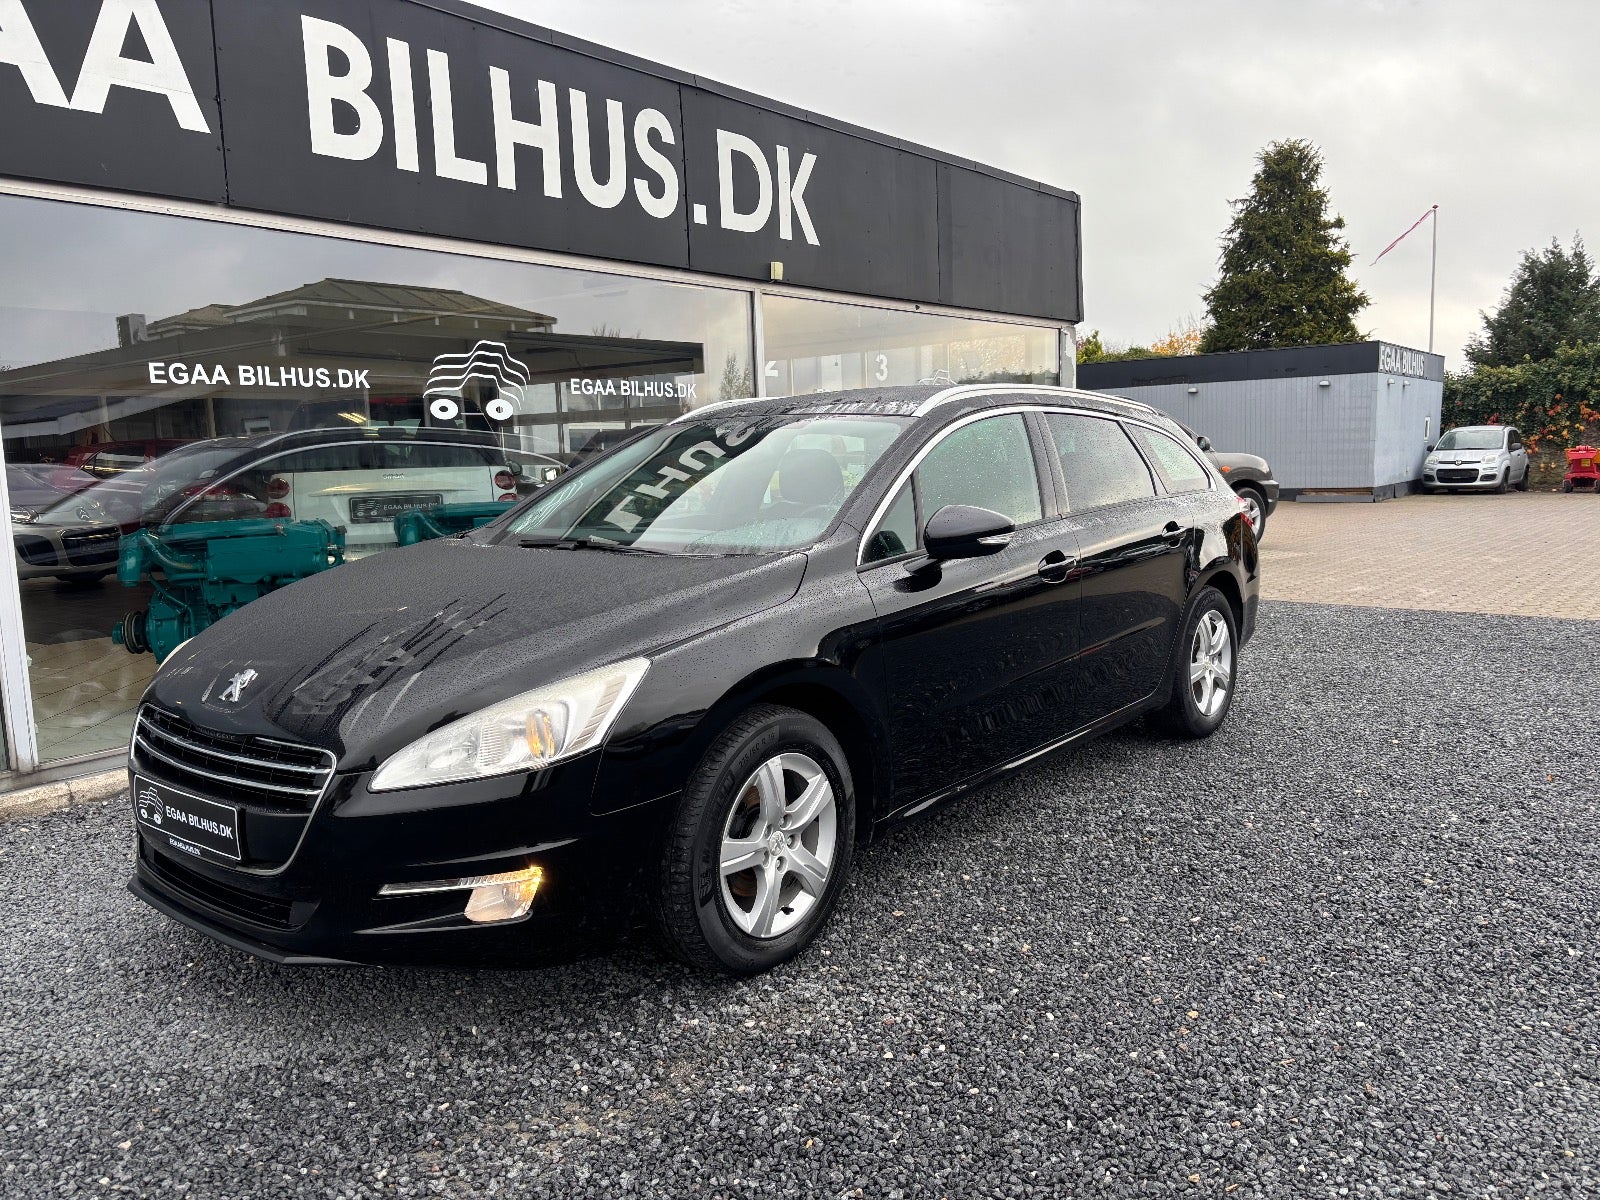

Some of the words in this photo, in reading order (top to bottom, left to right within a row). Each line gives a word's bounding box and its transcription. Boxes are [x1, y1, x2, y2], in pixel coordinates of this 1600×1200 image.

[300, 14, 820, 246] BILHUS.DK
[148, 362, 231, 385] EGAA
[238, 365, 371, 389] BILHUS.DK
[875, 354, 888, 381] 3
[1380, 345, 1401, 373] EGAA
[1402, 350, 1424, 377] BILHUS
[570, 378, 617, 396] EGAA
[620, 380, 697, 399] BILHUS.DK
[165, 805, 188, 824] EGAA
[188, 813, 234, 840] BILHUS.DK
